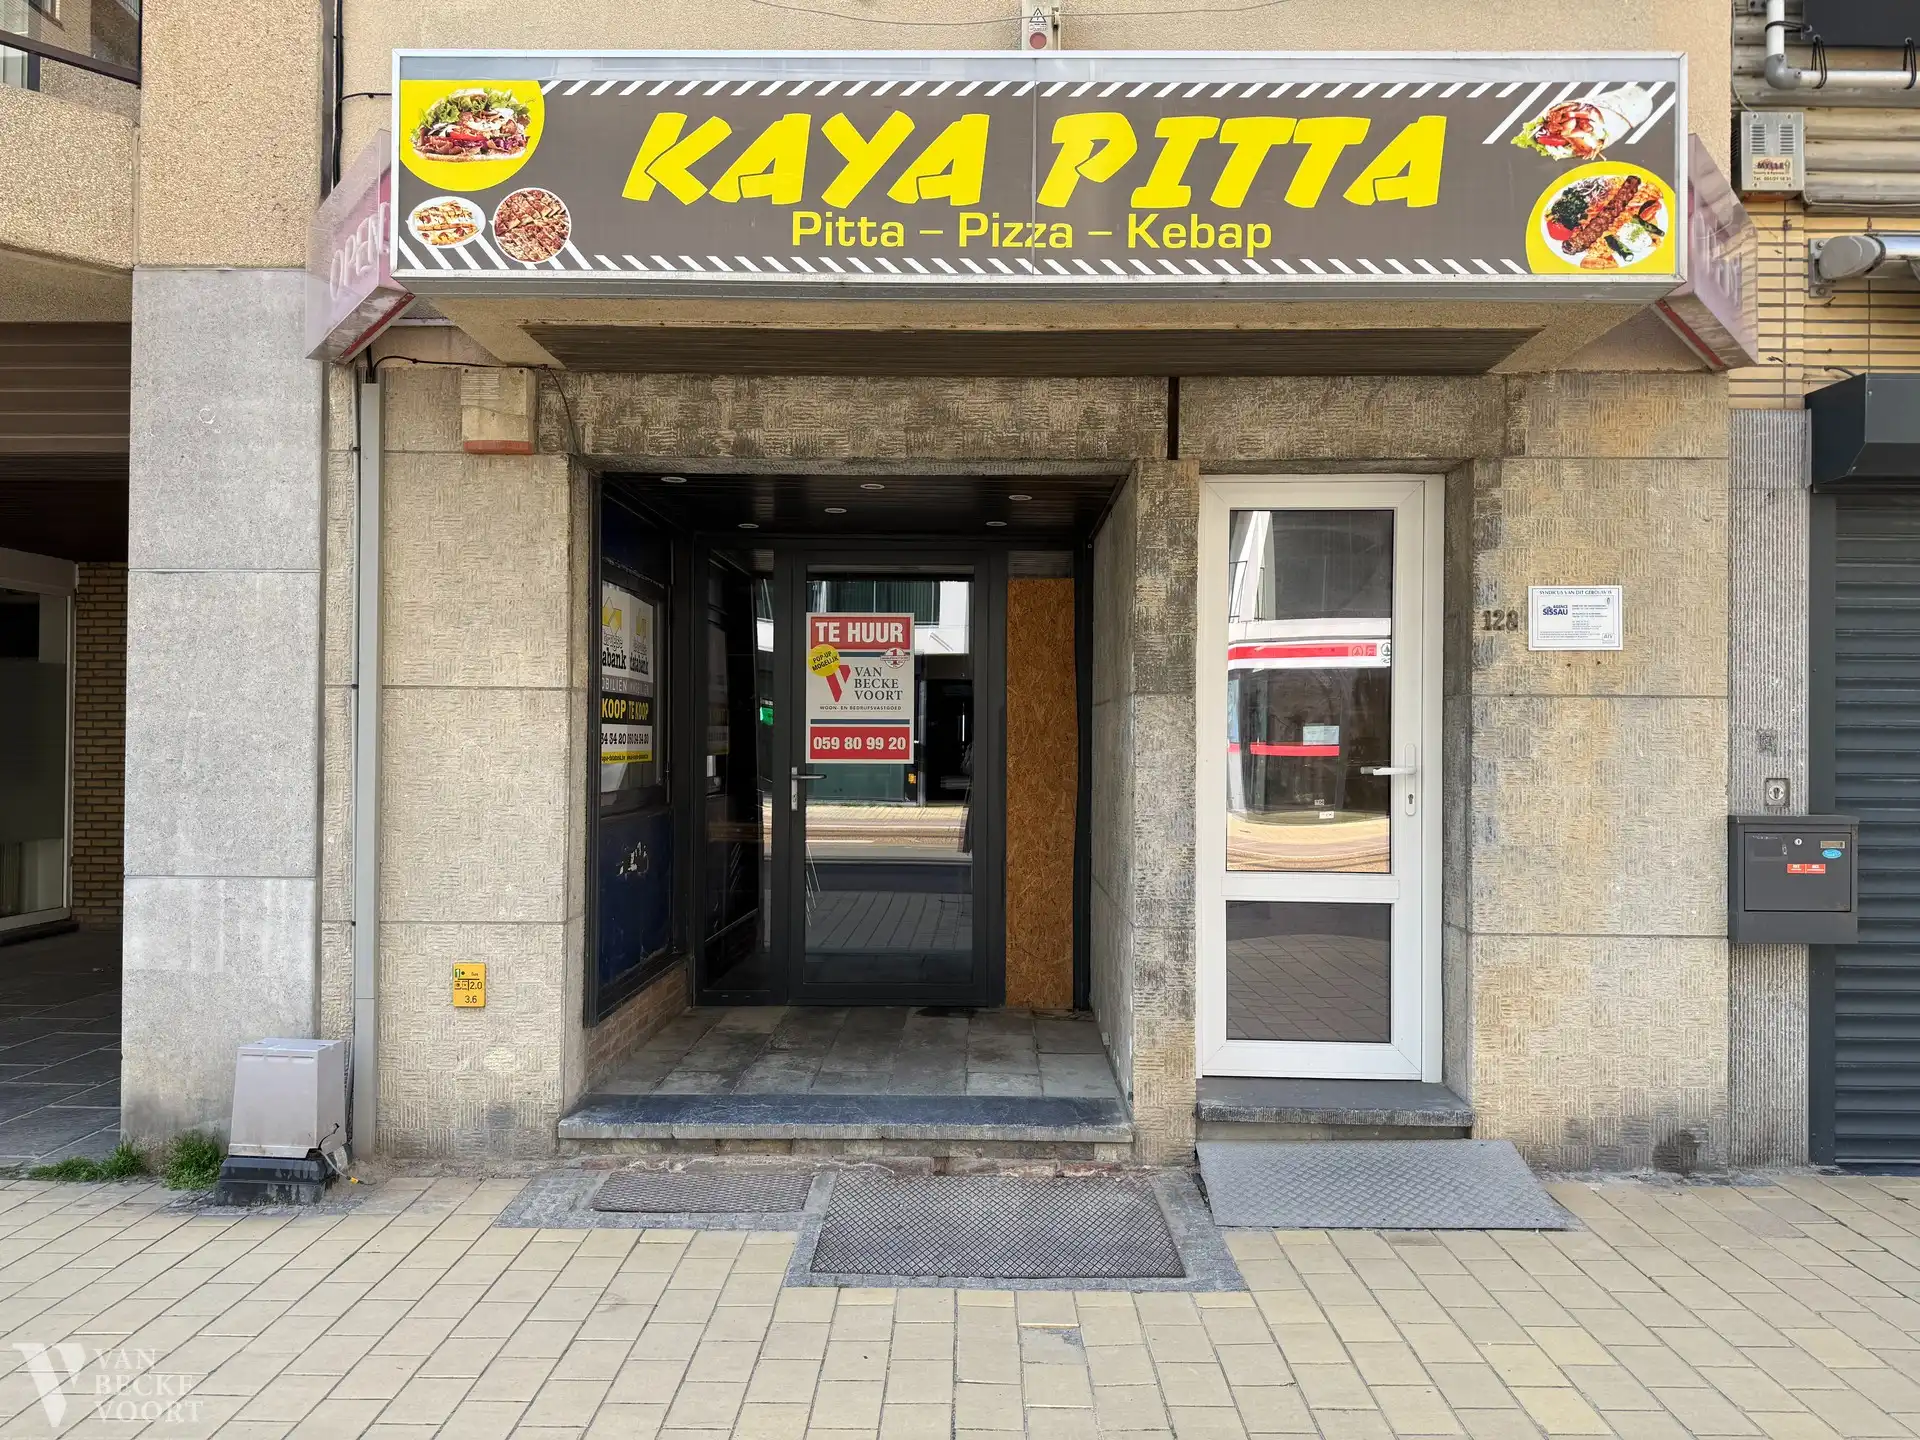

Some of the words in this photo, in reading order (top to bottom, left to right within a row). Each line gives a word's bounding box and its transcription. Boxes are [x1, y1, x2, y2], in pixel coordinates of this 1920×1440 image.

[622, 110, 990, 209] KAYA
[1037, 112, 1447, 209] PITTA
[791, 211, 905, 248] Pitta
[959, 211, 1073, 248] Pizza
[1128, 212, 1272, 259] Kebap
[1542, 608, 1568, 616] SISSAU
[815, 622, 840, 643] TE
[847, 622, 904, 643] HUUR
[812, 651, 832, 663] POP-UP
[812, 655, 839, 672] MOGELIJK
[854, 667, 883, 678] VAN
[854, 678, 899, 689] BECKE
[854, 690, 903, 701] VOORT
[602, 698, 627, 719] KOOP
[628, 700, 635, 719] TE
[635, 701, 649, 720] KOOP
[813, 737, 840, 750] 059
[844, 737, 862, 750] 80
[866, 737, 884, 750] 99
[888, 737, 907, 750] 20
[469, 981, 483, 990] 2.0
[464, 995, 478, 1004] 3.6
